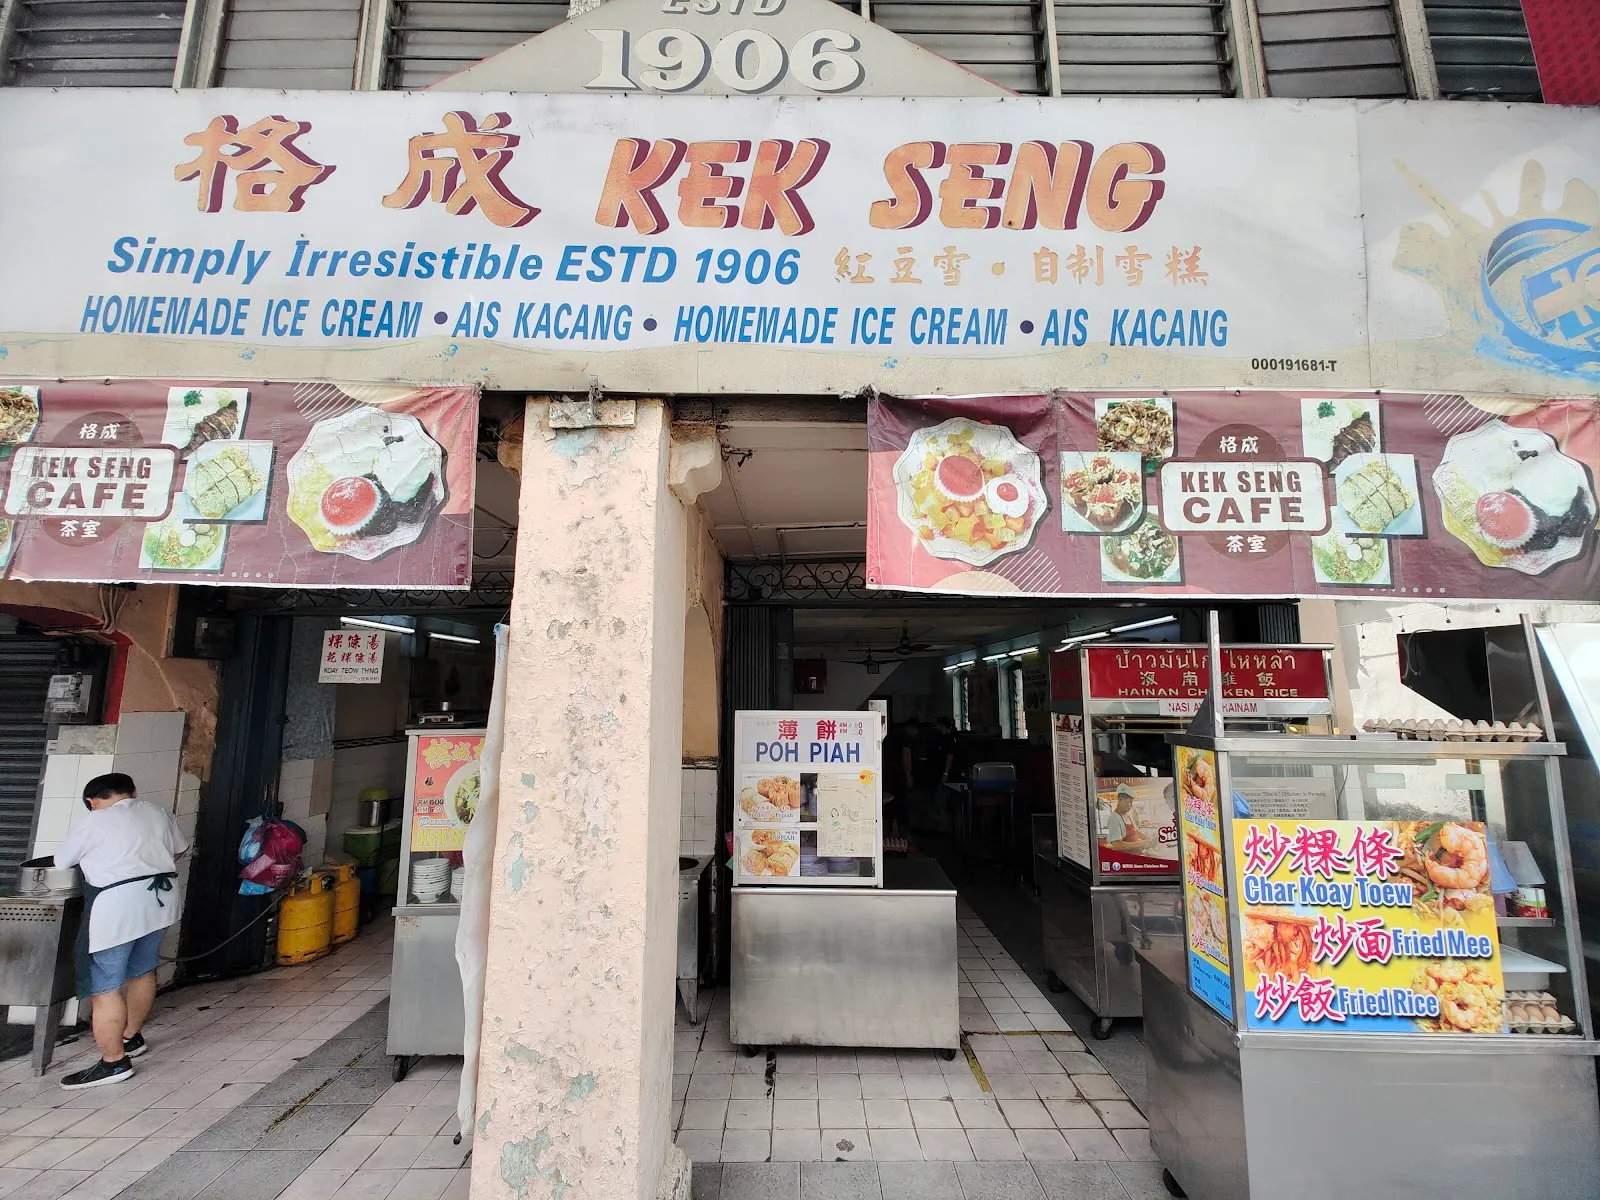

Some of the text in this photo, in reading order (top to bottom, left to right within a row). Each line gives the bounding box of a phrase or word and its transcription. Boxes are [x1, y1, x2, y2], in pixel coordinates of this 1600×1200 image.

[582, 28, 866, 94] 1906
[174, 111, 541, 228] 格成
[595, 137, 1166, 236] KEK SENG
[107, 236, 800, 286] Simply Irresistible ESTD 1906
[834, 245, 1210, 288] 紅豆雪 自制雪糕
[80, 295, 1229, 348] HOMEMADE ICE CREAM AIS KACANG HOMEMADE ICE CREAM AIS KACANG
[1251, 358, 1337, 372] 000191681-T
[79, 422, 119, 441] 格成
[1219, 434, 1259, 455] 格成
[31, 455, 153, 479] KEK SENG
[1181, 470, 1302, 493] KEK SENG
[27, 481, 149, 510] CAFE
[1182, 496, 1306, 525] CAFE
[59, 519, 101, 539] 茶室
[1225, 534, 1268, 554] 茶室
[1118, 688, 1298, 697] HAINAN CHKEN RICE
[1168, 702, 1190, 712] NASI
[778, 720, 837, 740] 薄餅
[756, 742, 860, 763] POH PIAH
[1243, 823, 1404, 878] 炒粿條
[1244, 874, 1413, 909] Char Koay Toew
[1312, 915, 1394, 965] 炒面
[1392, 930, 1492, 958] Fried Mee
[1255, 972, 1345, 1022] 炒飯
[1338, 988, 1440, 1018] Fried Rice
